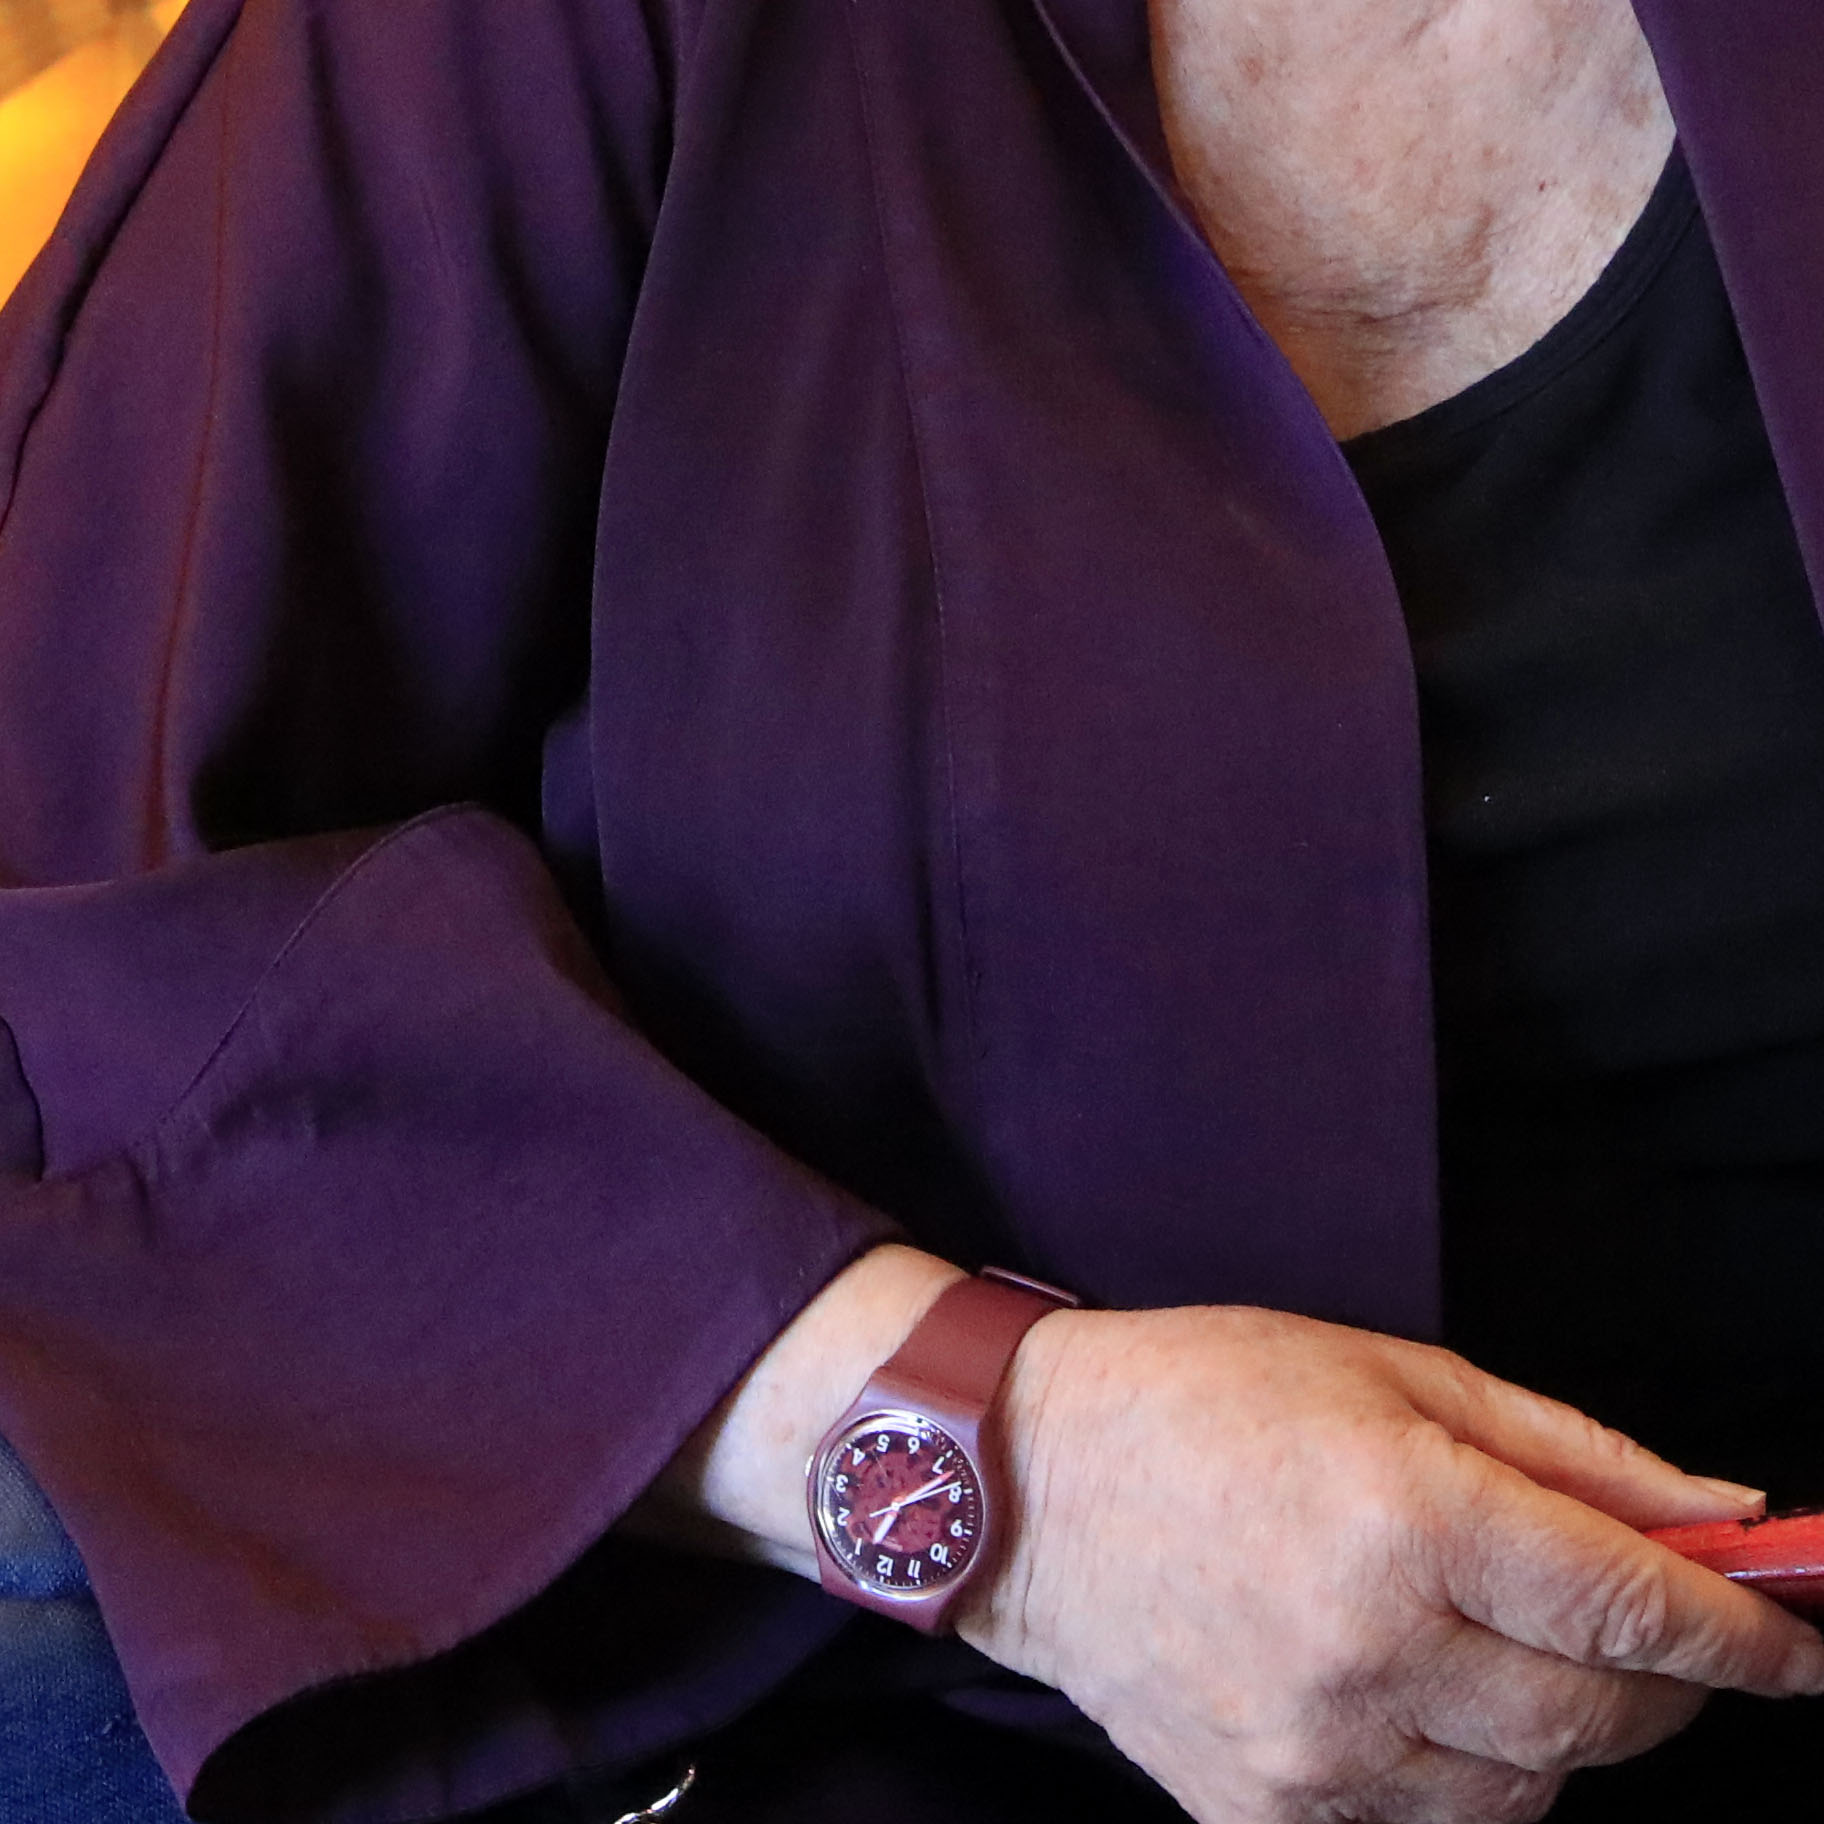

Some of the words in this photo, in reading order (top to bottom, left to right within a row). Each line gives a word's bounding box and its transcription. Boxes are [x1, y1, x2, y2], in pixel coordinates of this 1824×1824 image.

[876, 1434, 890, 1452] 5
[908, 1437, 920, 1454] 6
[852, 1448, 866, 1466] 4
[932, 1456, 945, 1474] 7
[836, 1474, 849, 1493] 3
[949, 1486, 962, 1503] 8
[837, 1507, 850, 1526] 2
[950, 1520, 963, 1537] 9
[855, 1538, 863, 1555] 1
[930, 1543, 948, 1565] 10
[877, 1555, 894, 1576] 12
[908, 1560, 921, 1578] 11
